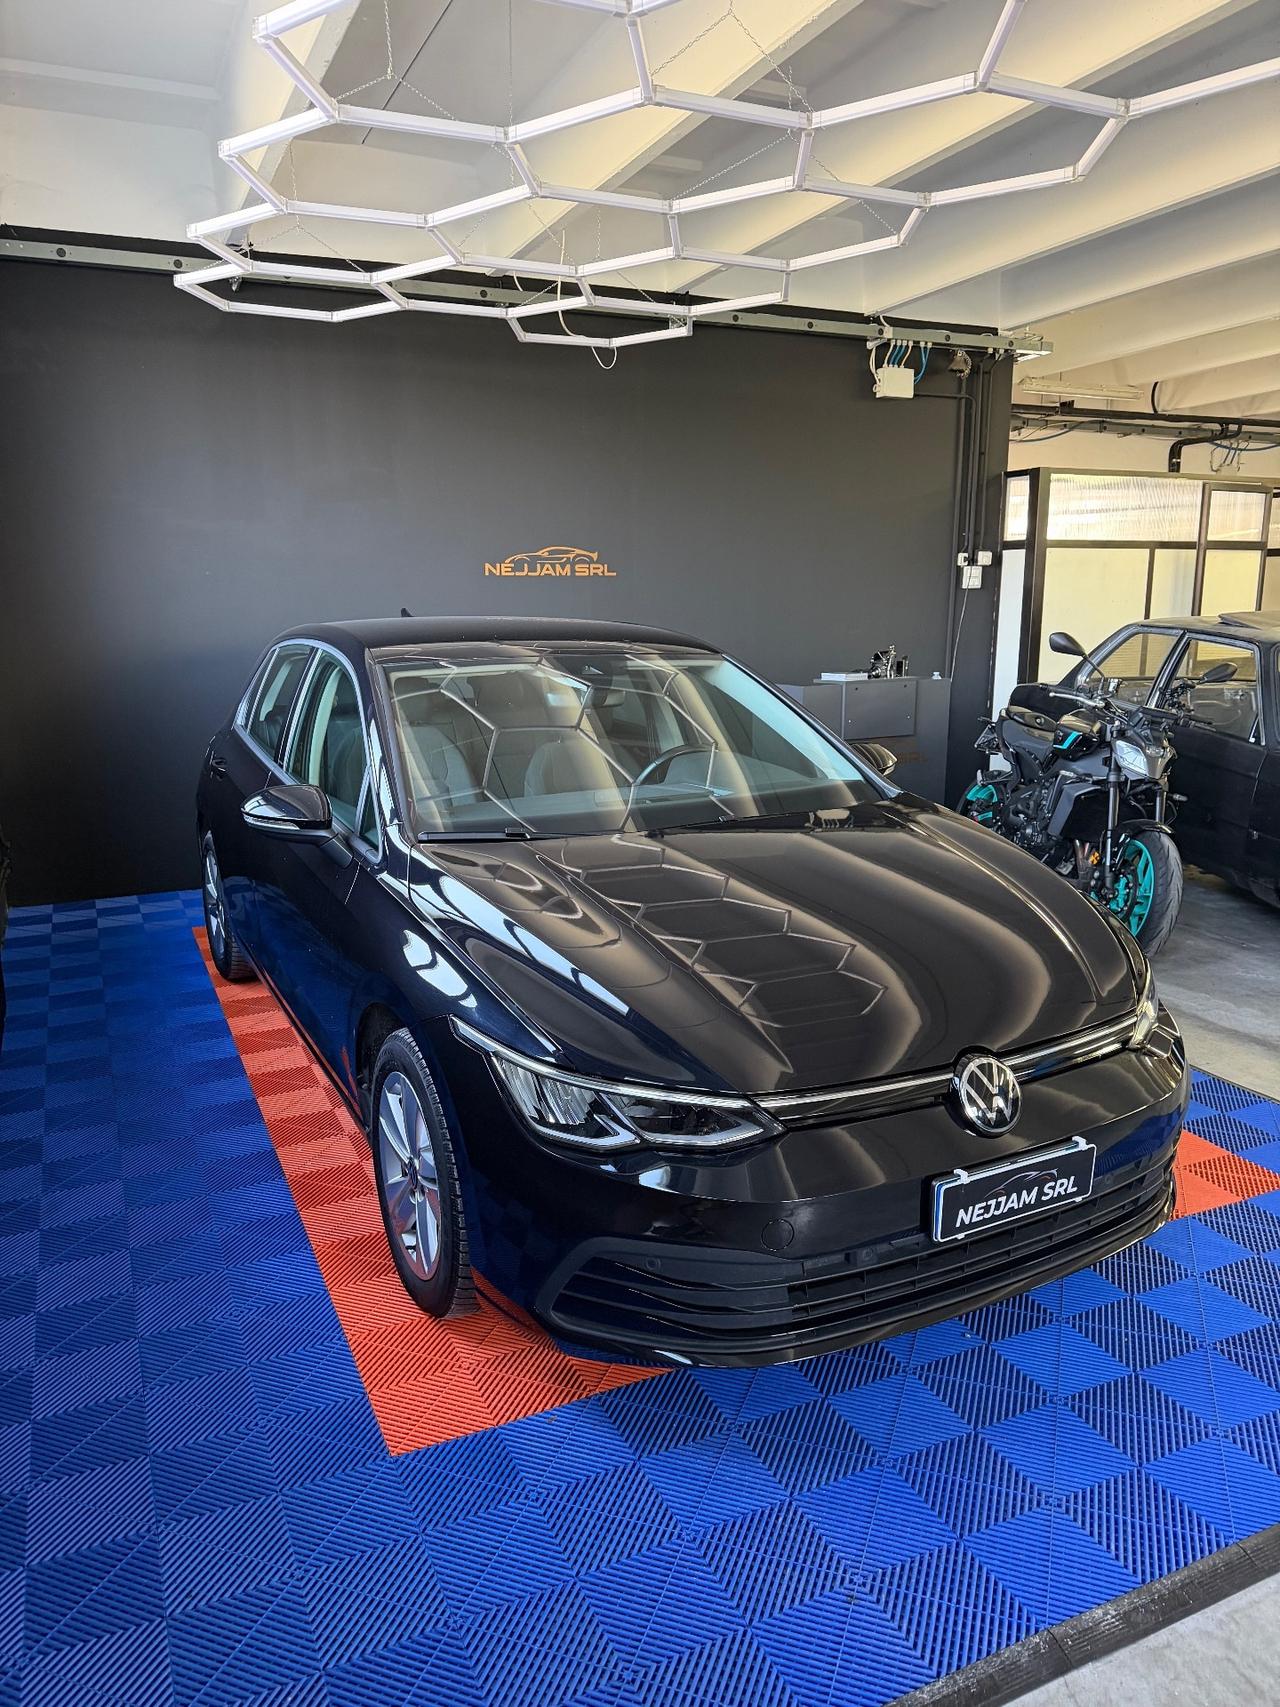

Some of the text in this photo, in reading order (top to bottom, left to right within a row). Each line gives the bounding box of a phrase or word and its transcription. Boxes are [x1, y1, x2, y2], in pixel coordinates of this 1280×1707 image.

[484, 562, 617, 577] NEJJAM SRL
[955, 1175, 1078, 1228] NEJJAM SRL
